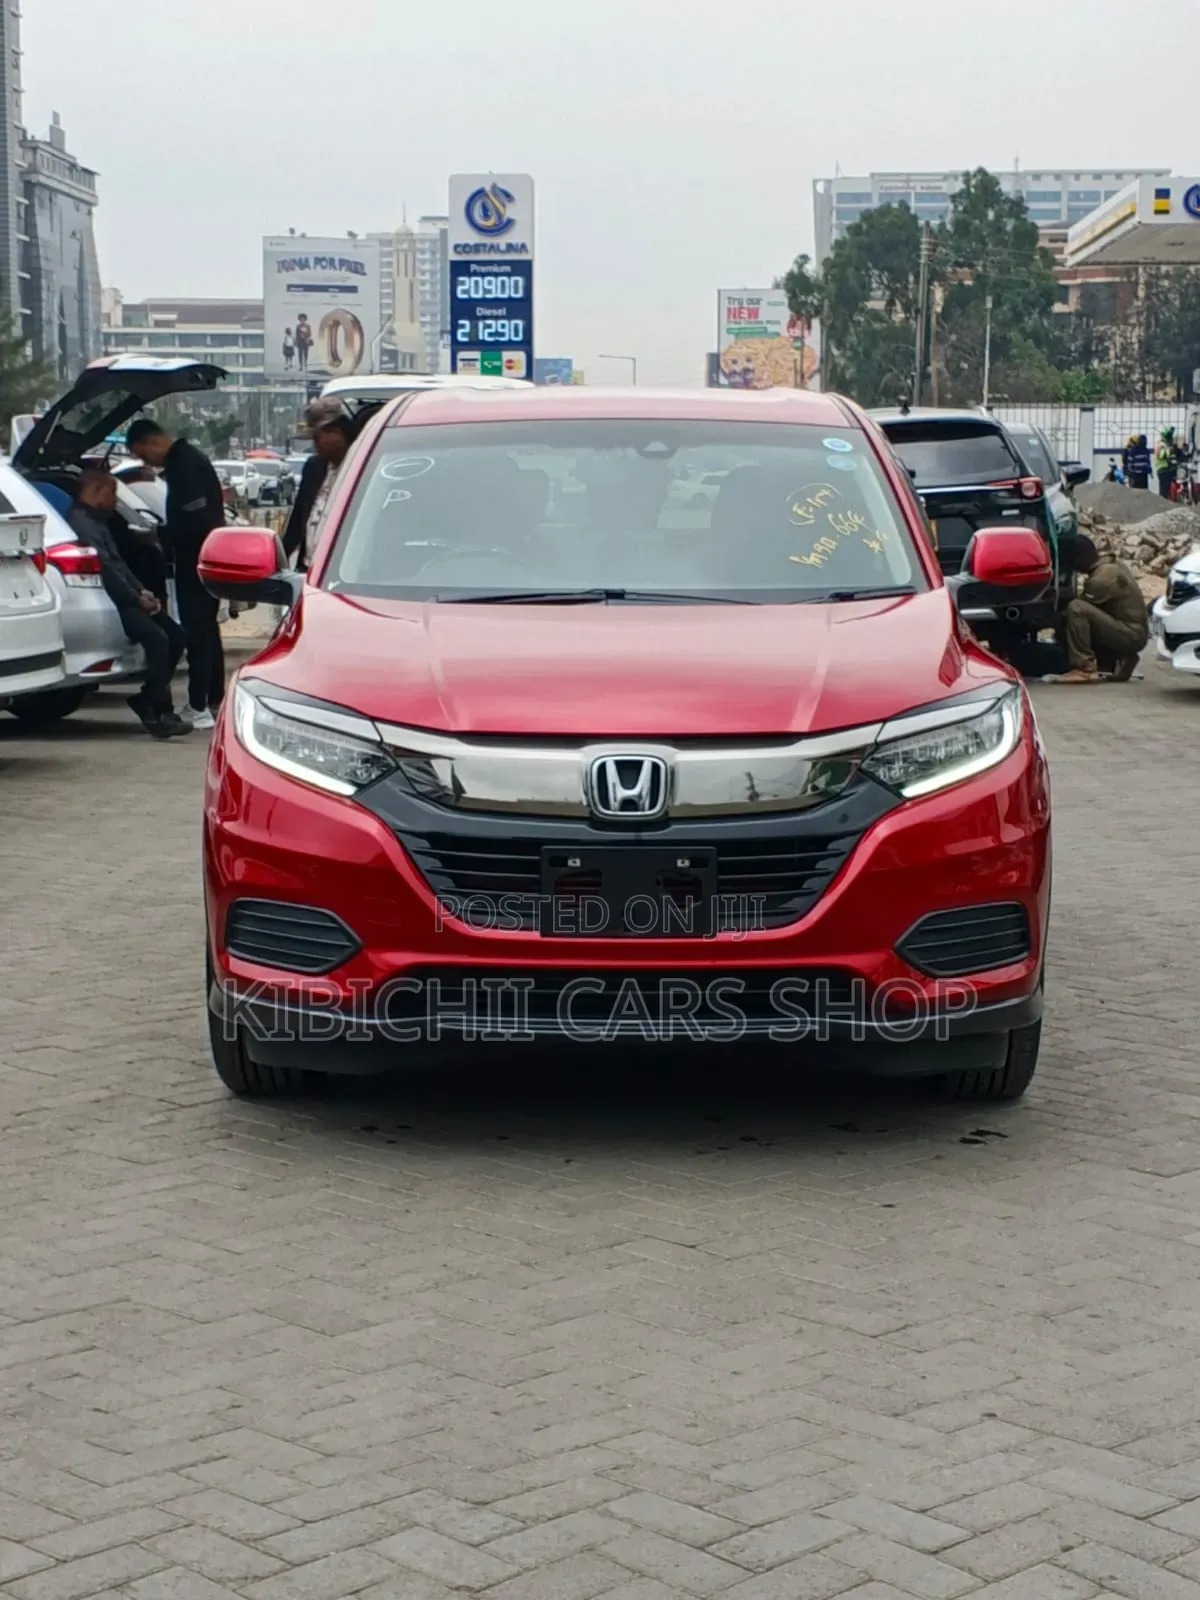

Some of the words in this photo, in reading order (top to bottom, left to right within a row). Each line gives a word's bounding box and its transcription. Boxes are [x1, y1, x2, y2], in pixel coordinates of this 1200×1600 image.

[453, 243, 529, 255] COSTALINA
[470, 264, 512, 273] Premium
[476, 307, 507, 316] Diesel
[727, 306, 760, 320] NEW
